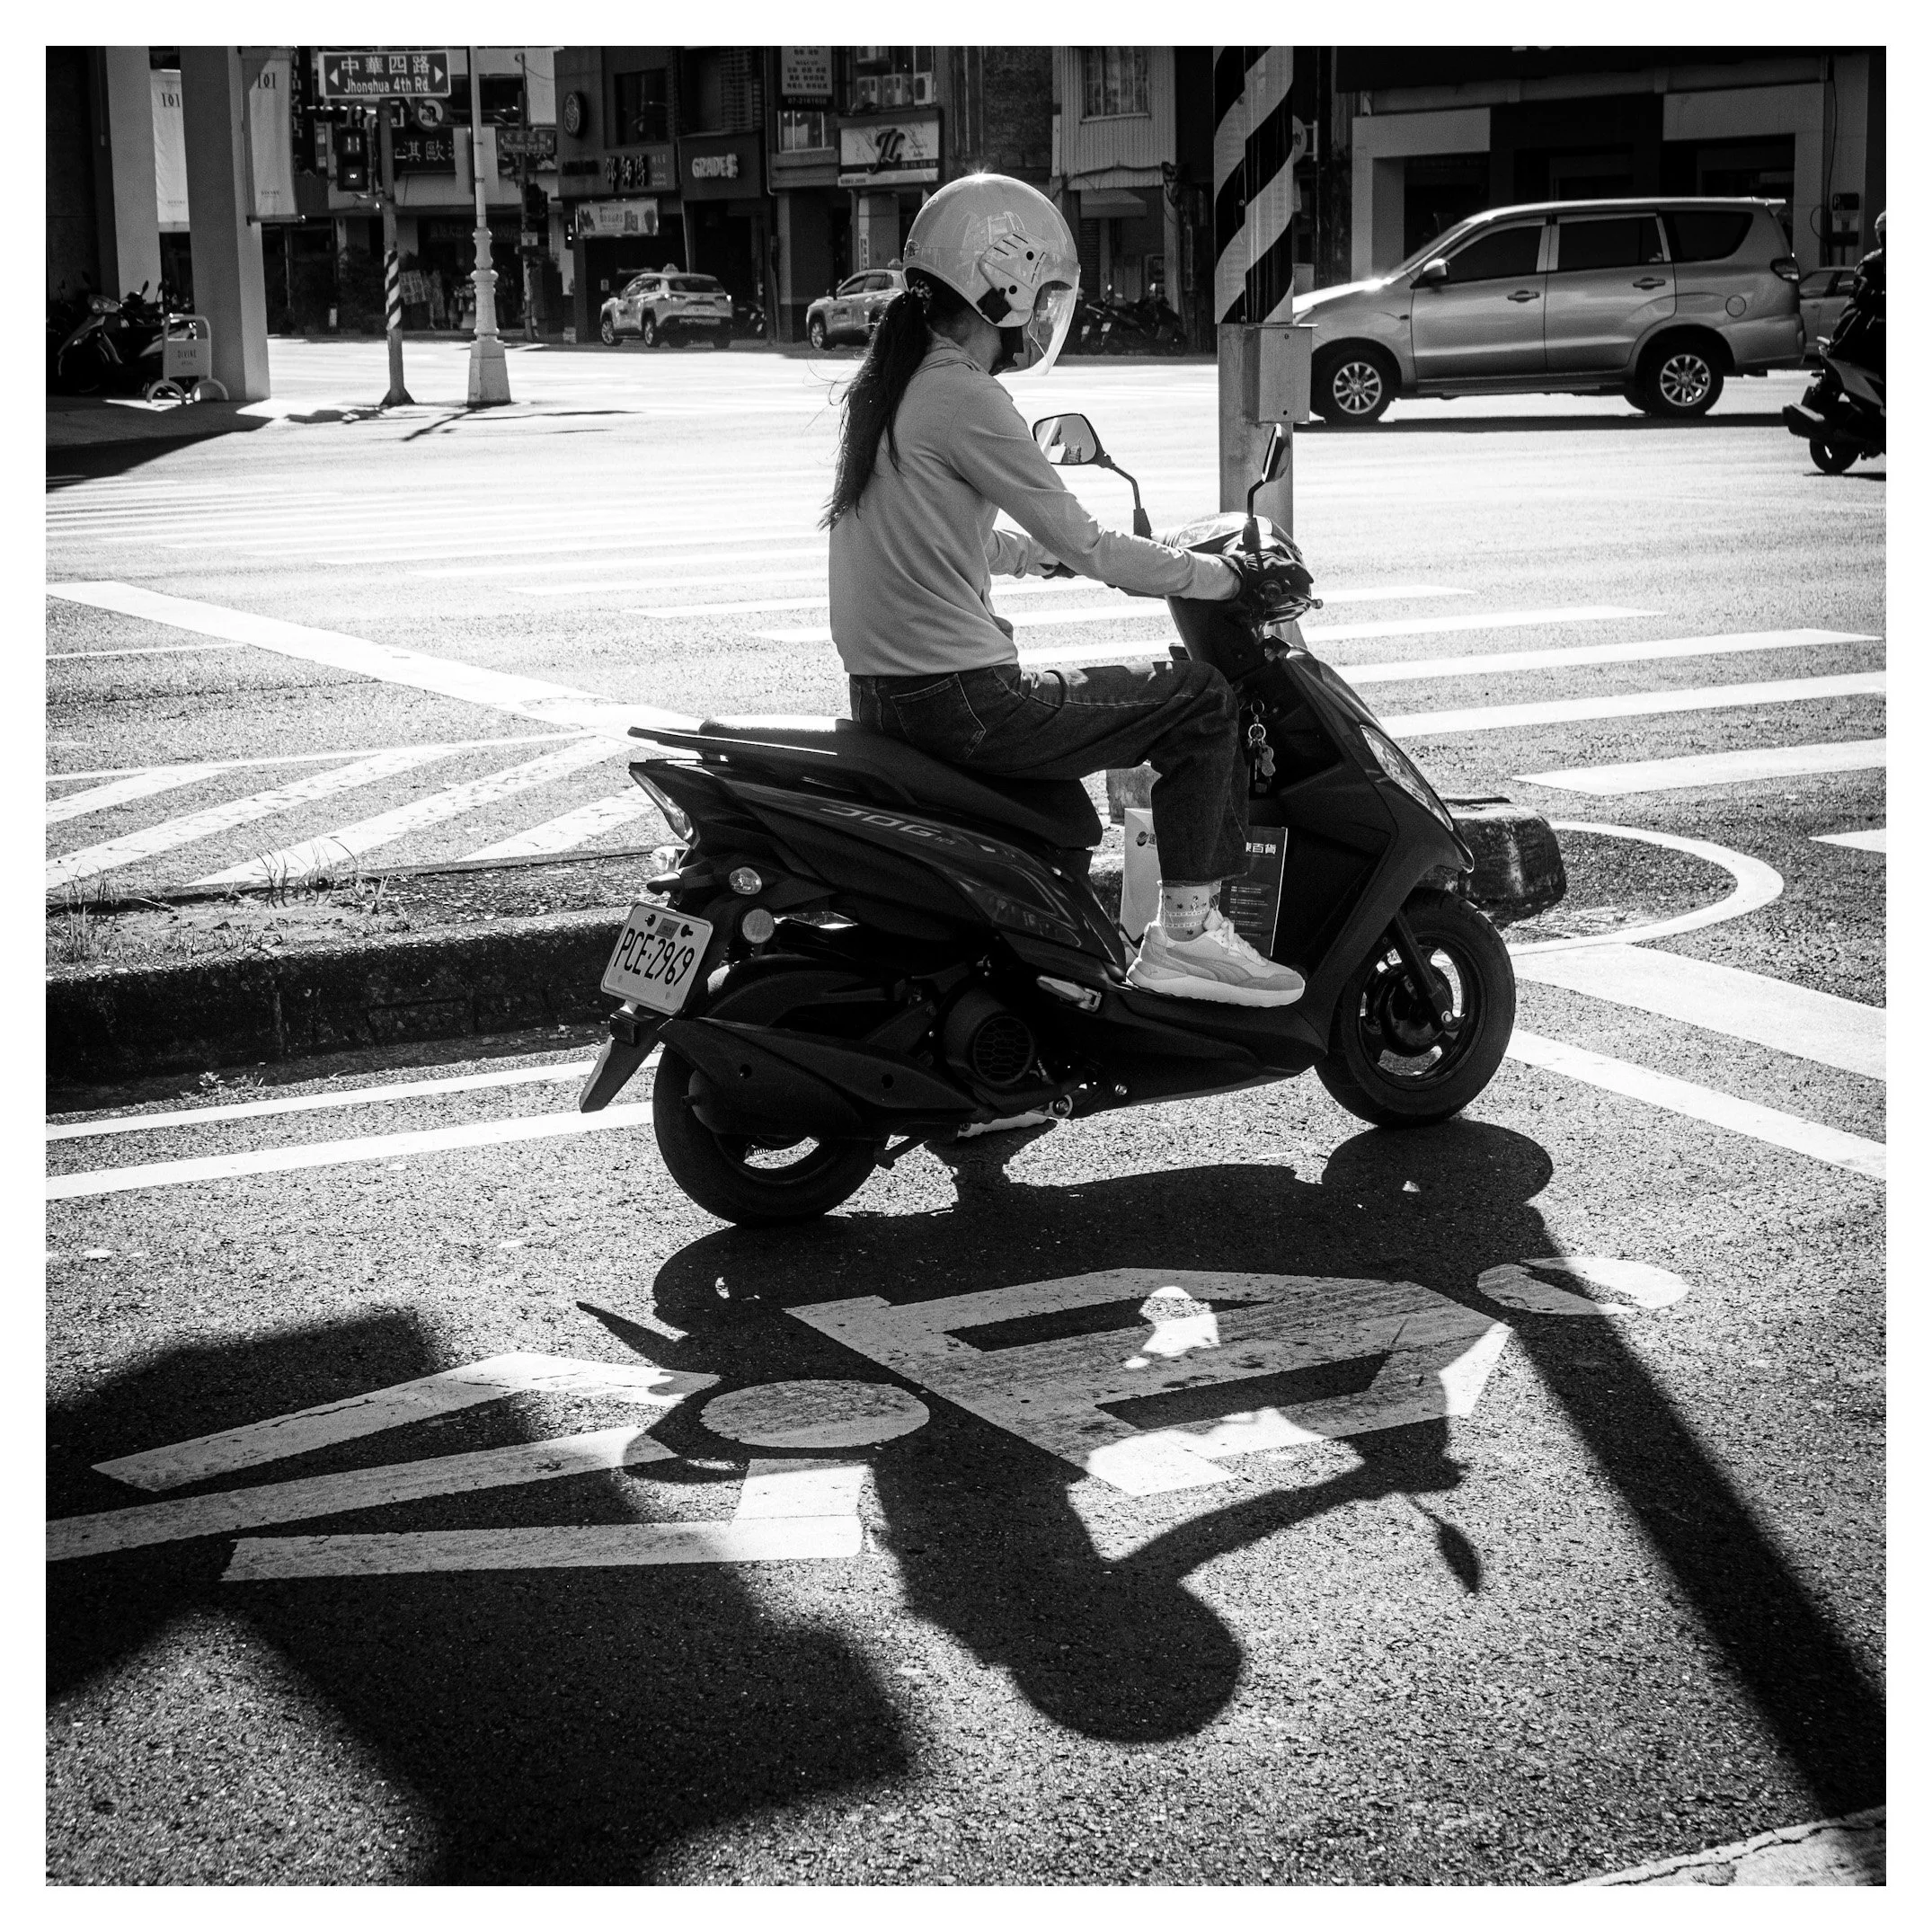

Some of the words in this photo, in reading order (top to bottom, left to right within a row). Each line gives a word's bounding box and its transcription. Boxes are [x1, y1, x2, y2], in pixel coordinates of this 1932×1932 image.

[341, 55, 430, 76] 中華四路
[257, 72, 276, 90] 101
[343, 77, 390, 94] Jhonghua
[393, 76, 412, 93] 4th
[161, 93, 181, 108] 101
[819, 807, 942, 837] JOG
[613, 927, 696, 987] PCE-2969
